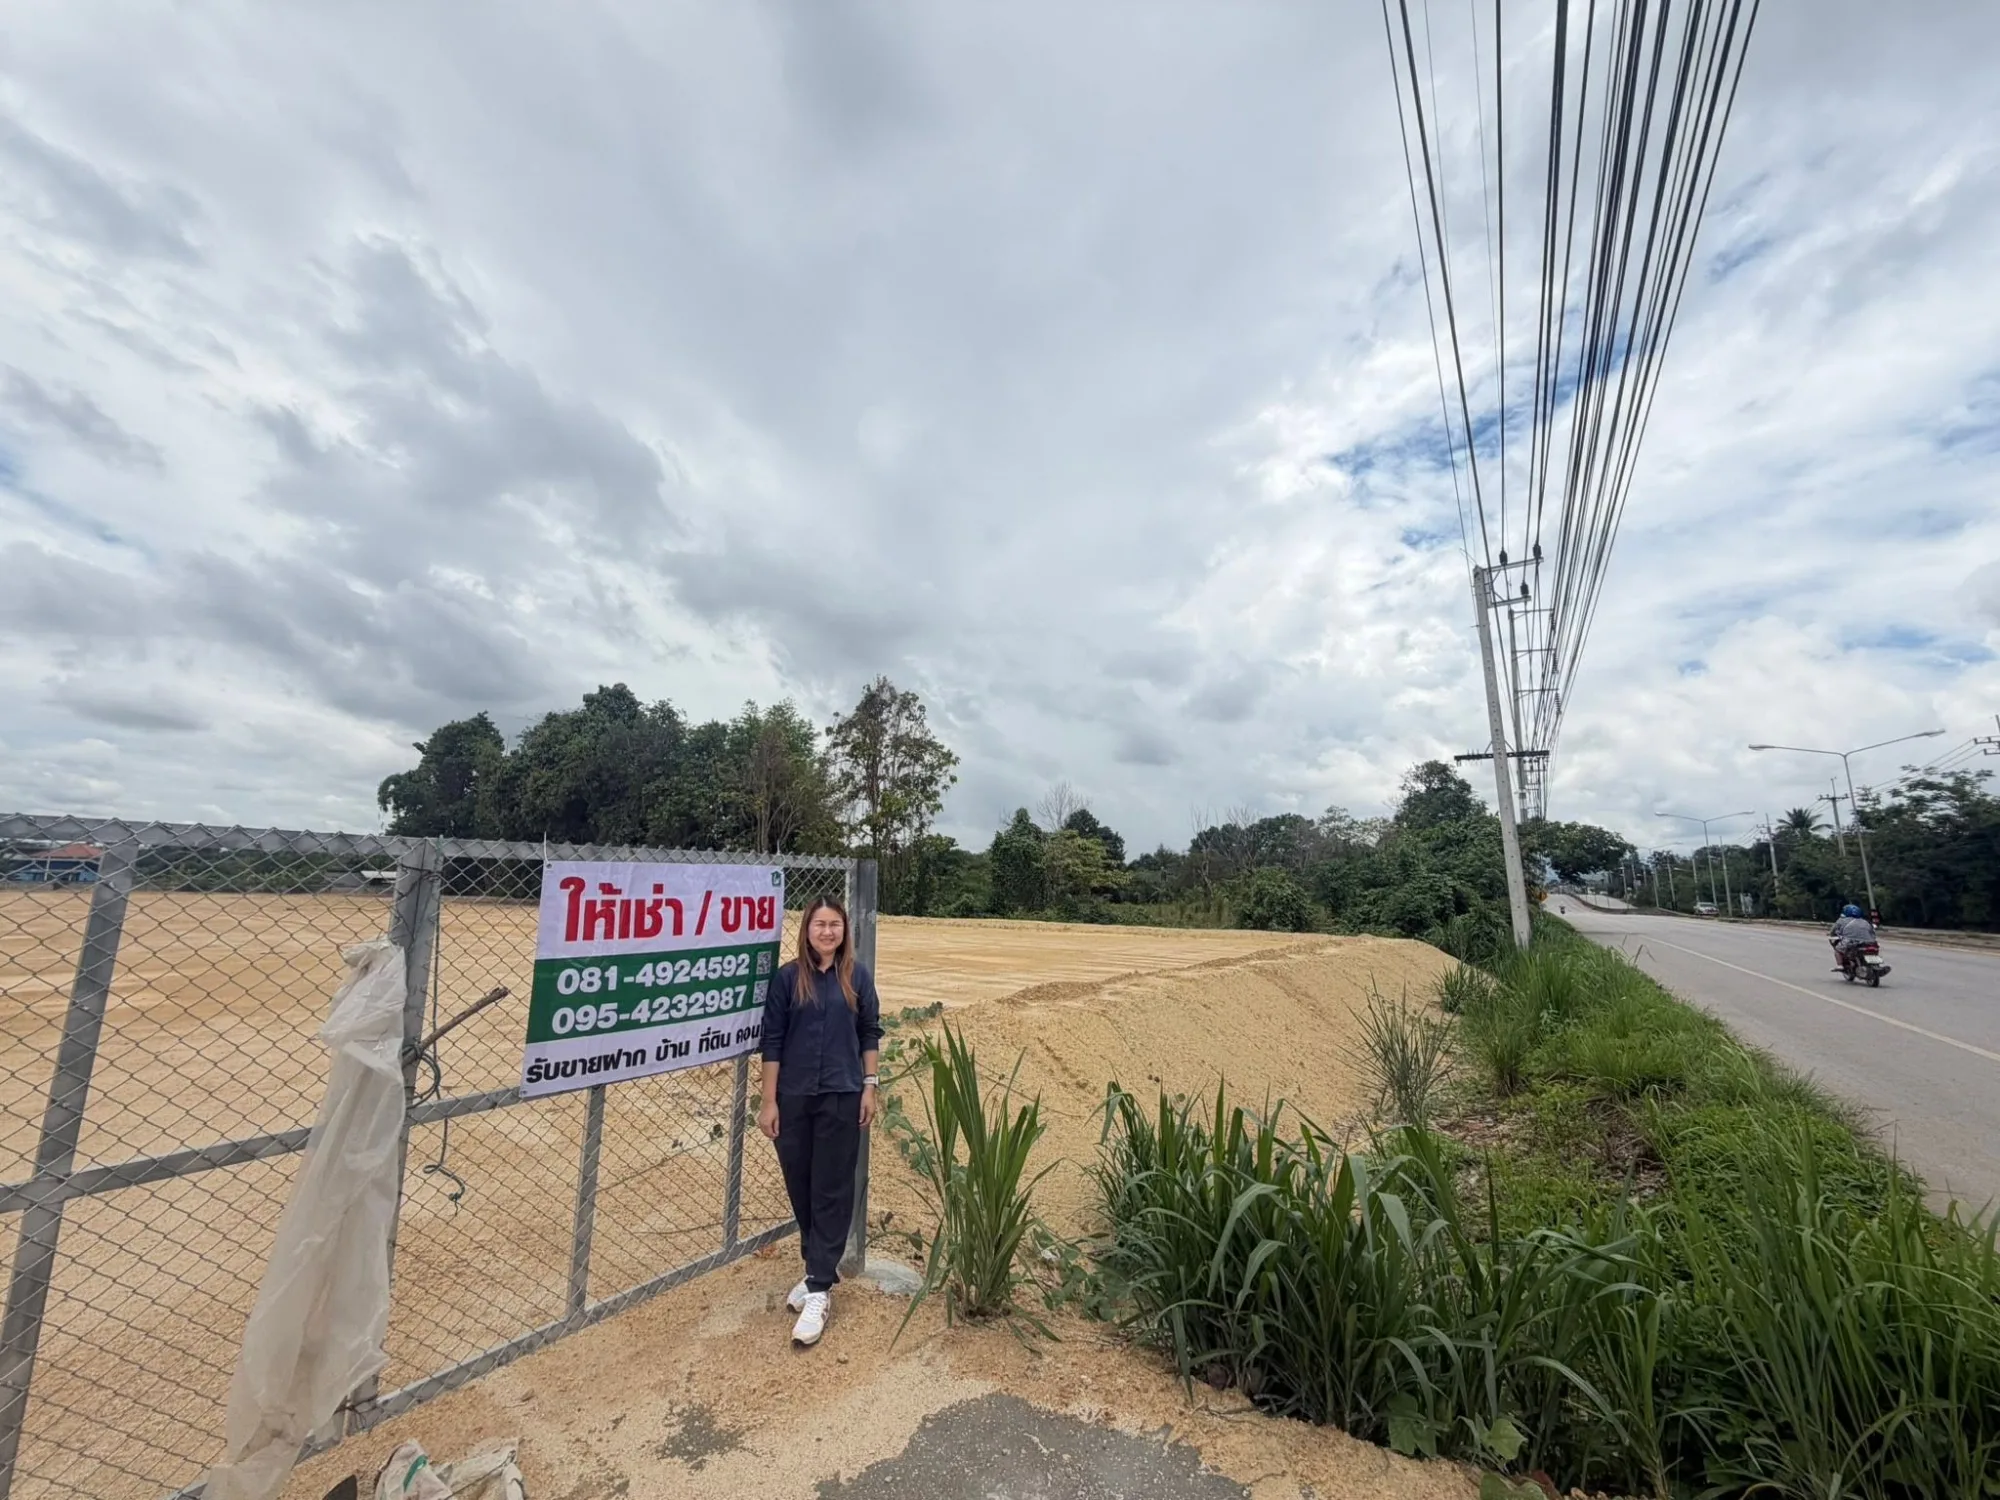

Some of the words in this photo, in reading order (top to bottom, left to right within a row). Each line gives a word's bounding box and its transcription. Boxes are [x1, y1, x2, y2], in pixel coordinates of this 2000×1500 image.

[559, 876, 683, 942] ให้เช่า
[695, 890, 713, 936] /
[721, 896, 775, 933] ขาย
[557, 953, 750, 995] 081-4924592
[551, 985, 747, 1035] 095-4232987
[526, 1048, 646, 1084] รับขายฝาก
[655, 1038, 691, 1062] บ้าน
[698, 1026, 732, 1053] ที่ดิน
